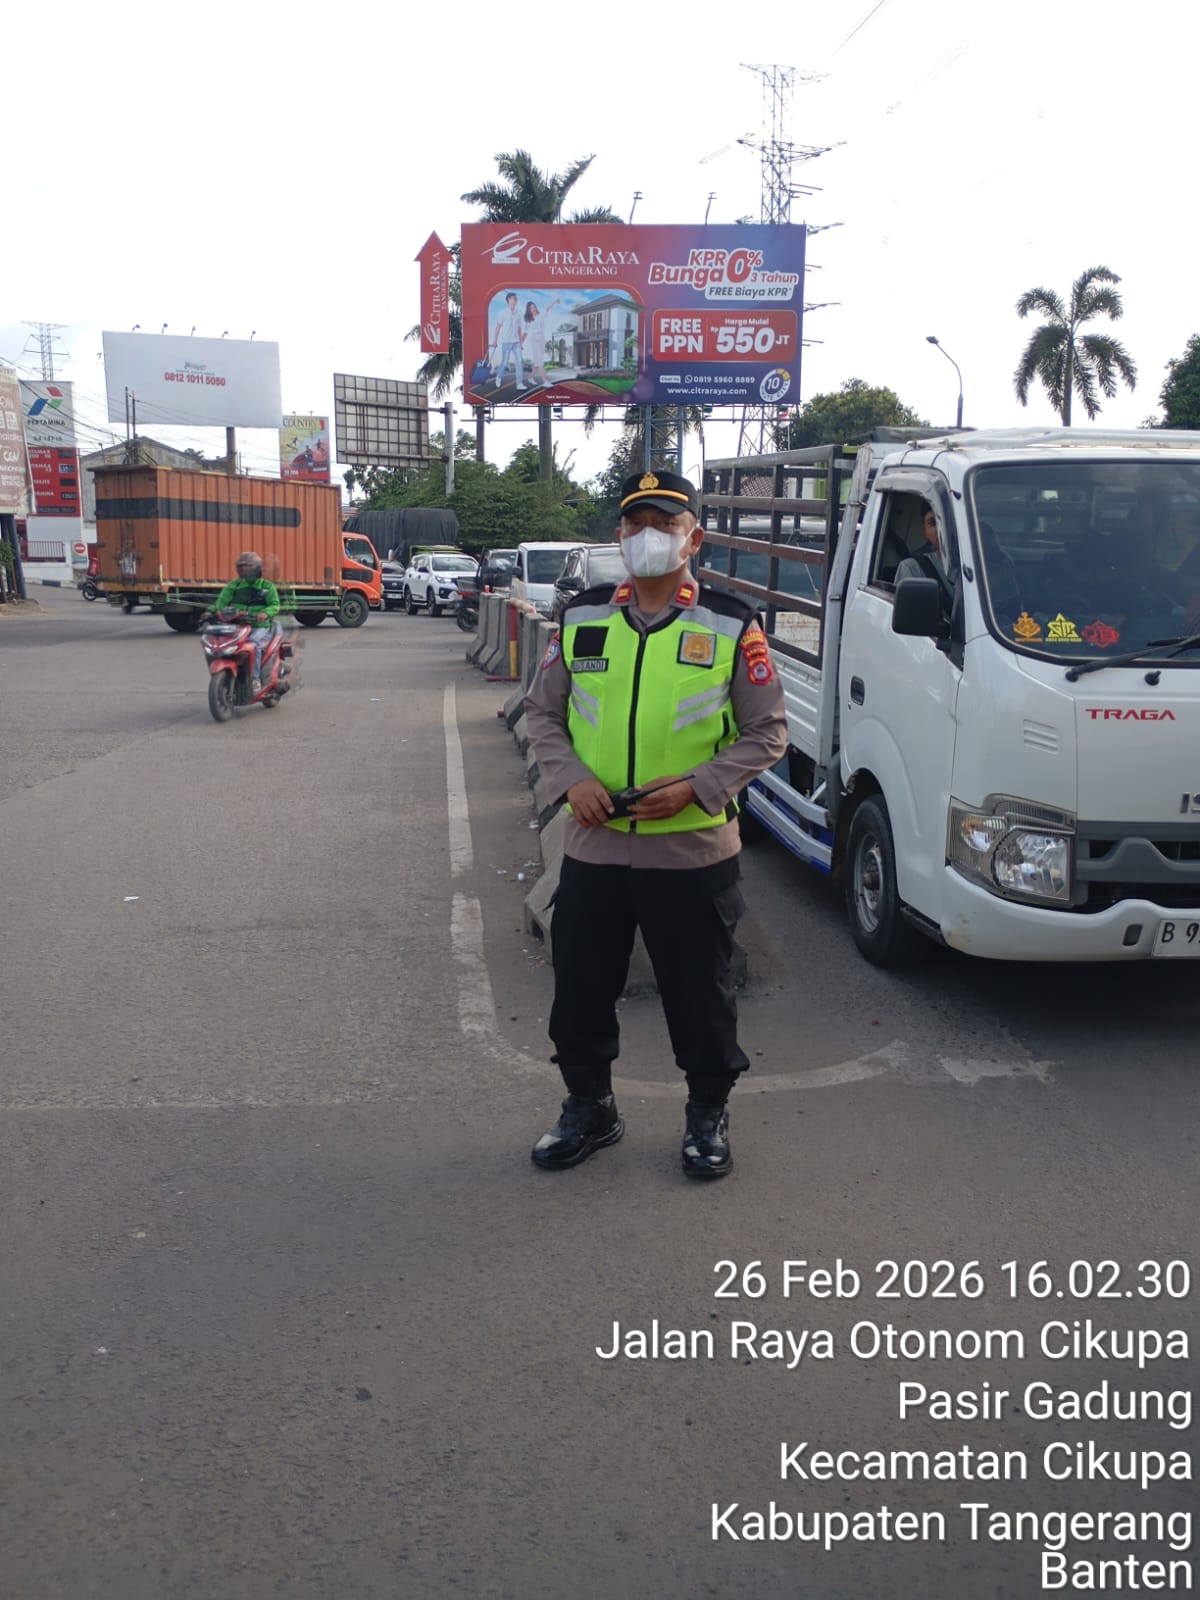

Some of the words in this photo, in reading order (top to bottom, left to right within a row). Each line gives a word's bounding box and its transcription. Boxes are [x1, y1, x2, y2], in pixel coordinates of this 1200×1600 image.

[689, 250, 727, 266] KPR
[549, 266, 618, 276] TANGERANG
[649, 264, 725, 289] Bunga
[750, 272, 758, 283] 3
[761, 272, 798, 284] Tahun
[708, 286, 733, 296] FREE
[734, 286, 766, 299] Biaya
[659, 318, 703, 334] FREE
[724, 317, 748, 327] Harga
[748, 317, 770, 326] Mulai
[659, 335, 704, 353] PPN
[716, 326, 776, 354] 550
[775, 335, 791, 345] JT
[164, 371, 185, 383] 0812
[186, 373, 204, 385] 1011
[766, 377, 780, 390] 10
[667, 386, 748, 396] www.citraraya.com
[1085, 708, 1176, 721] TRAGA
[1161, 921, 1175, 943] B
